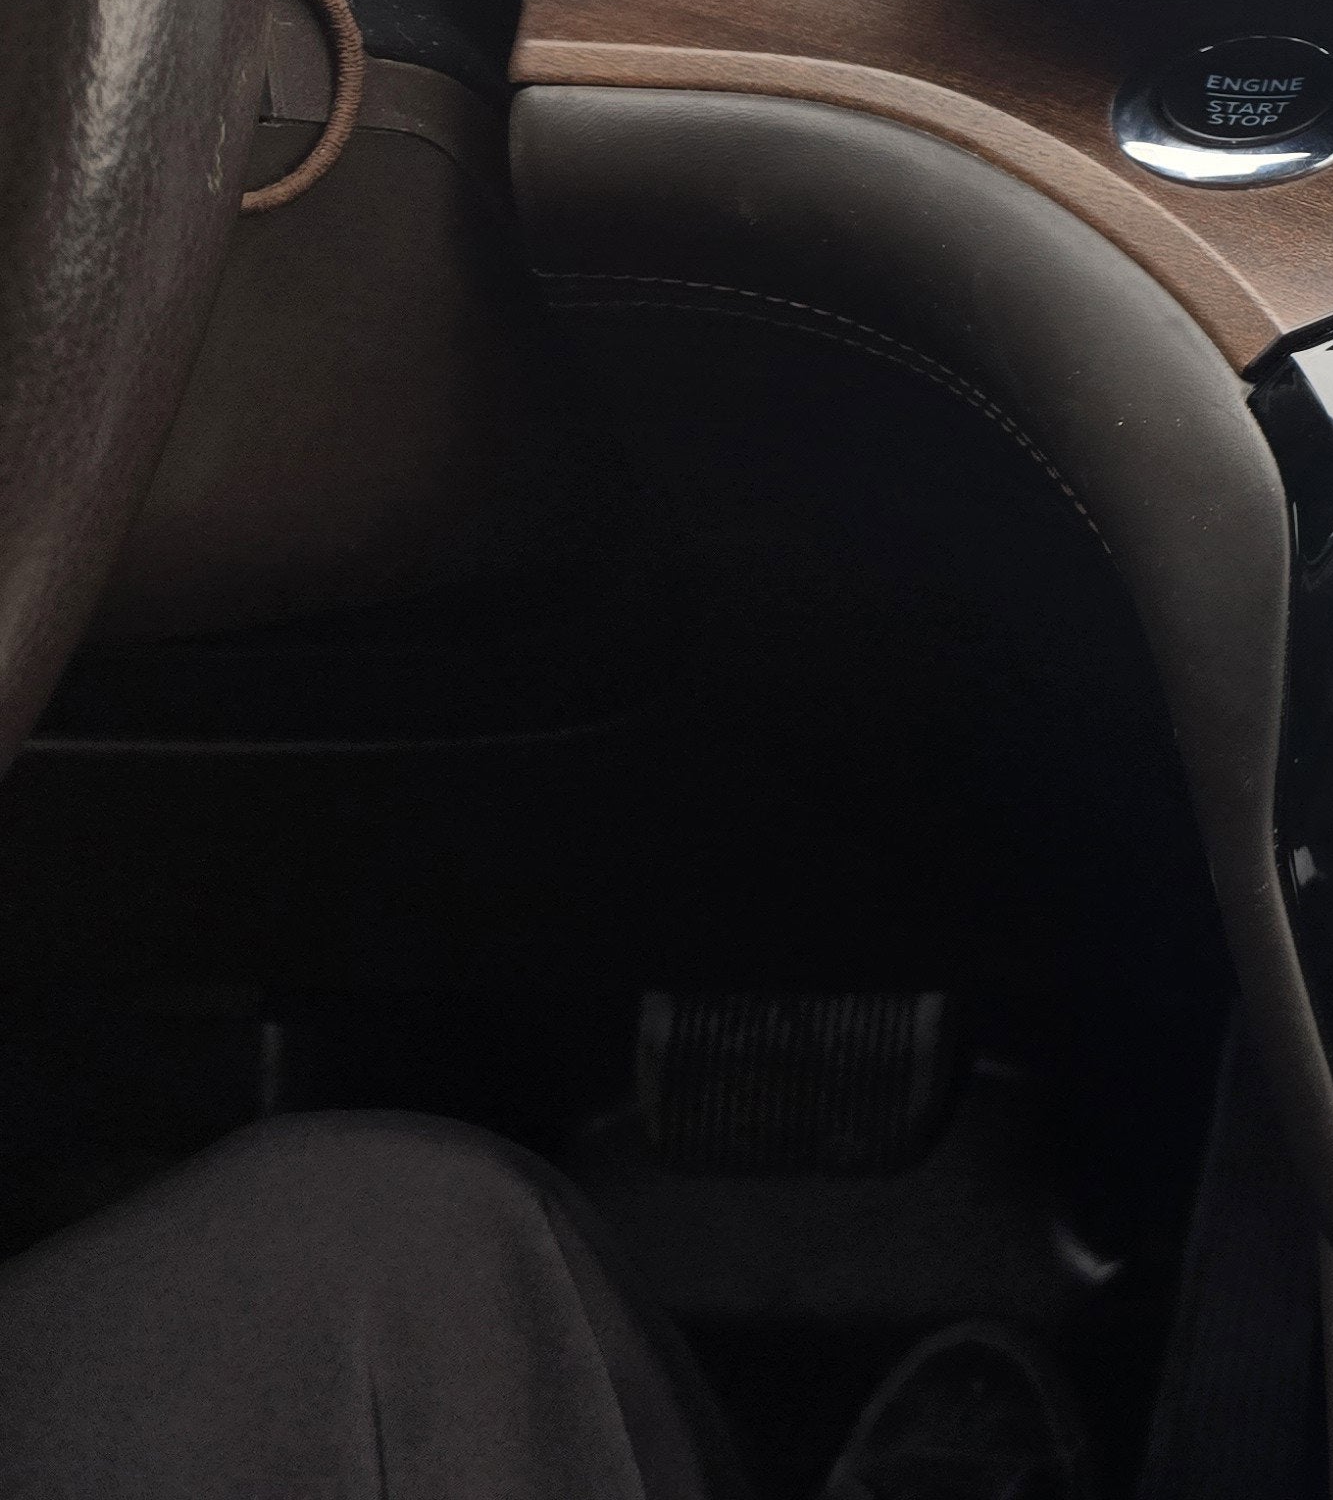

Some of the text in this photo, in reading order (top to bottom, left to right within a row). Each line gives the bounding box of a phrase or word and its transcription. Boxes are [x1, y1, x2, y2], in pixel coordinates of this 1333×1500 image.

[1206, 74, 1305, 92] ENGINE
[1206, 101, 1290, 115] START
[1207, 113, 1279, 126] STOP
